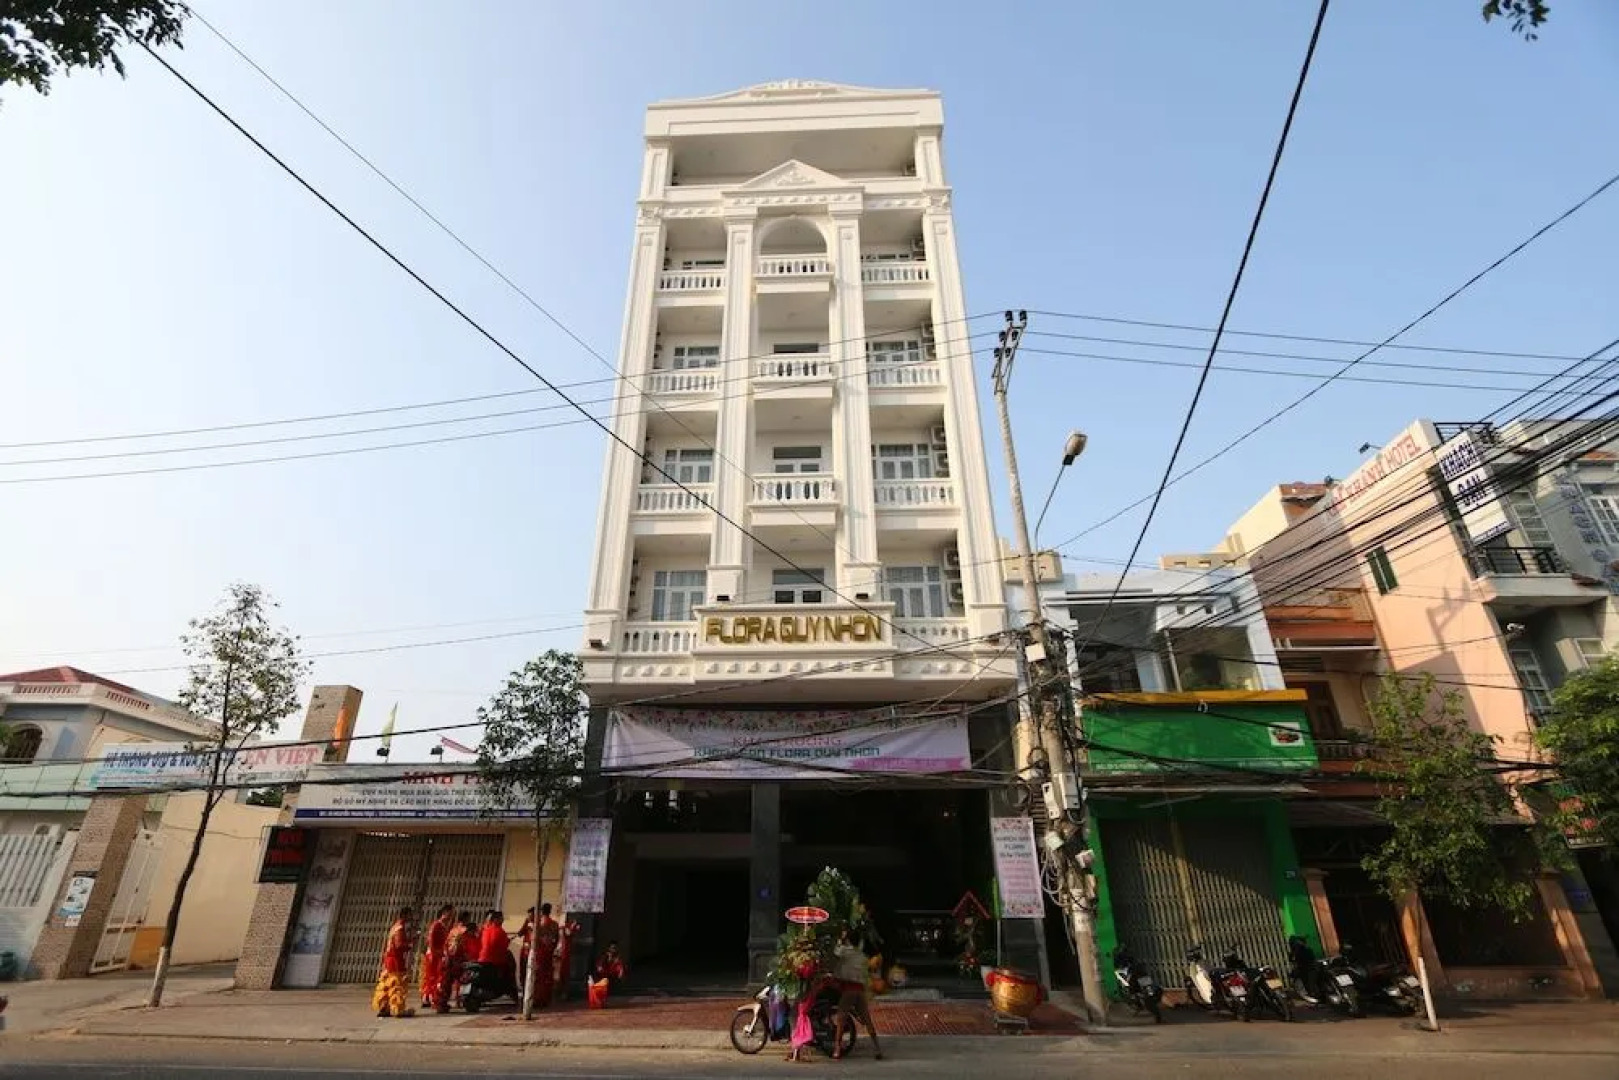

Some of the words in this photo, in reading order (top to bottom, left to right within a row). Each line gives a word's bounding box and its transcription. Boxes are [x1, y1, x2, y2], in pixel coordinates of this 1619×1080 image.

[1384, 433, 1421, 471] HOTEL
[706, 616, 777, 643] FLORA
[770, 747, 810, 757] FLORA
